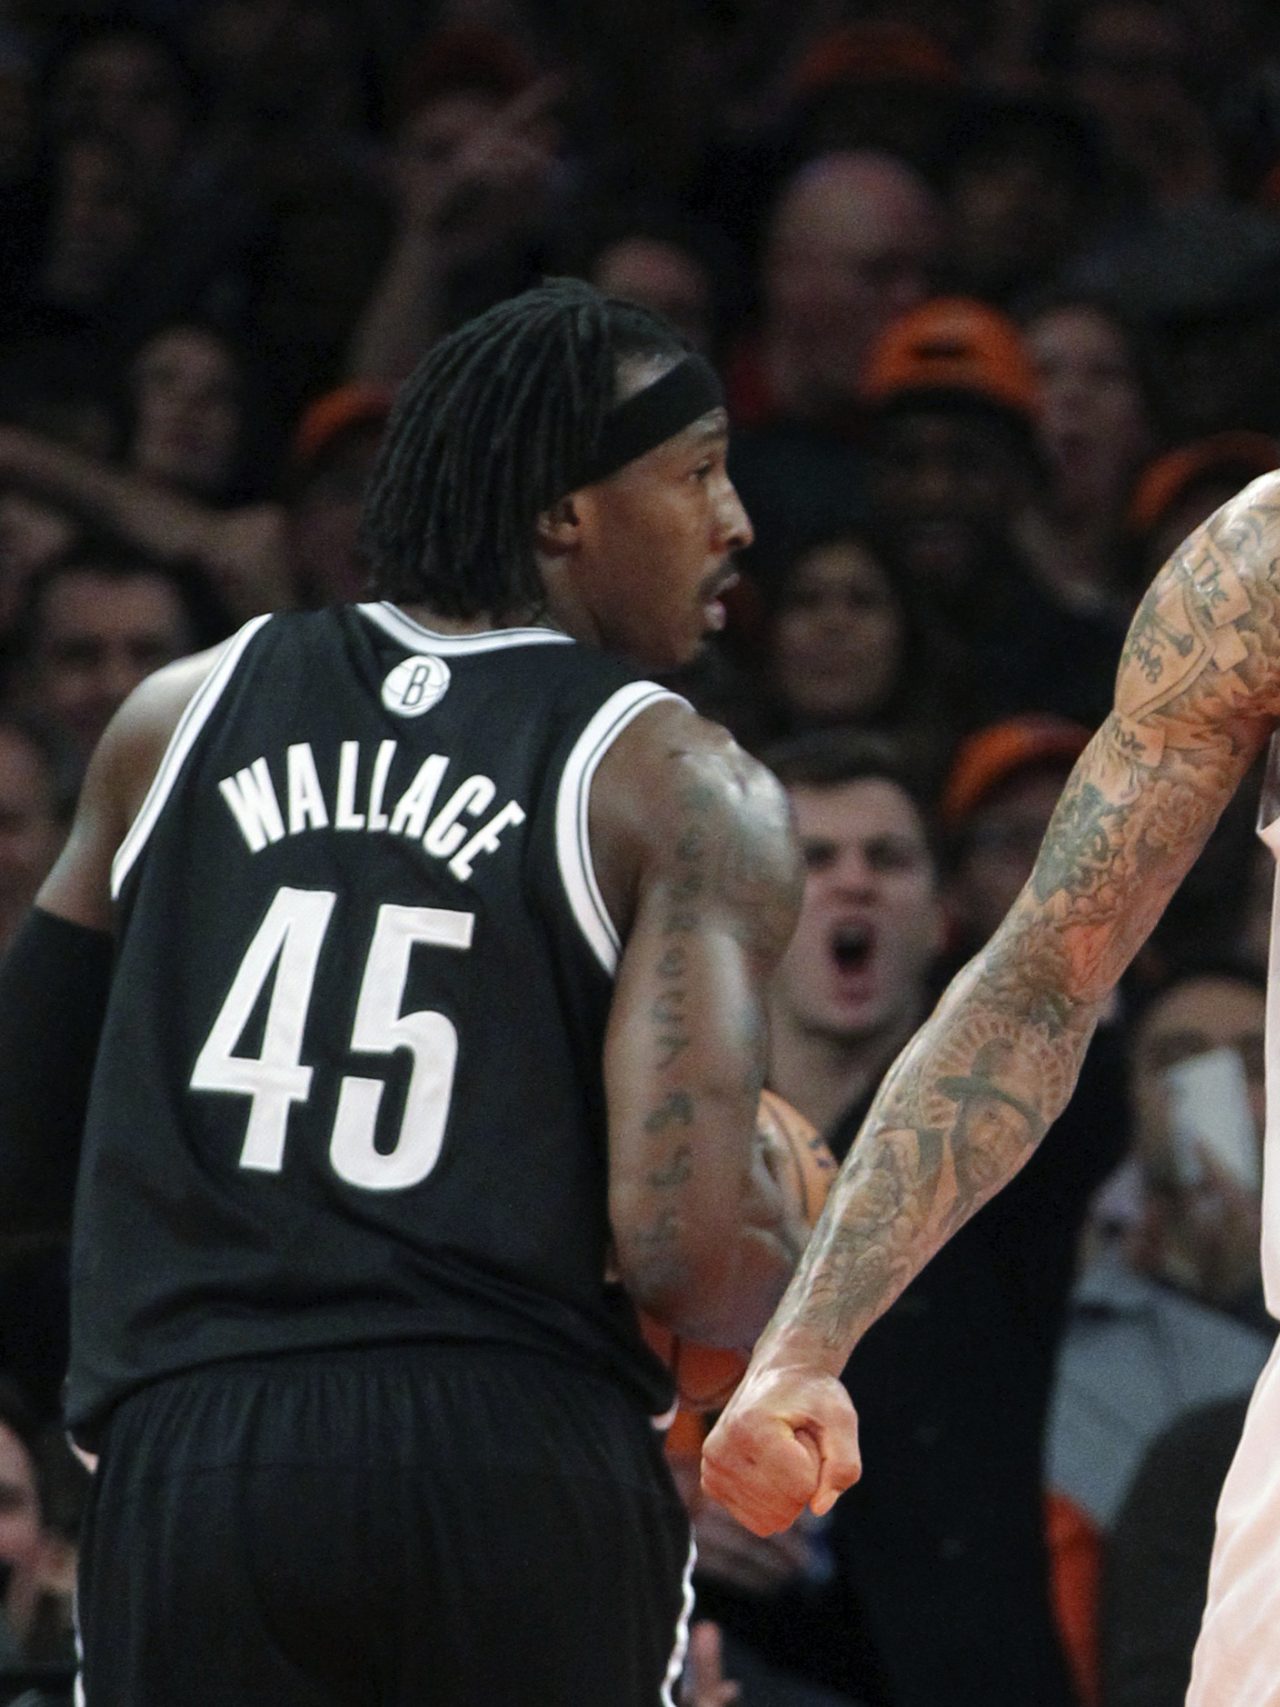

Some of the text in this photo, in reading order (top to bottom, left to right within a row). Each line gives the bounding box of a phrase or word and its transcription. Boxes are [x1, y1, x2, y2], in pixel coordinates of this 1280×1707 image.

[402, 664, 430, 706] B
[218, 740, 526, 882] WALLACE
[190, 886, 475, 1192] 45
